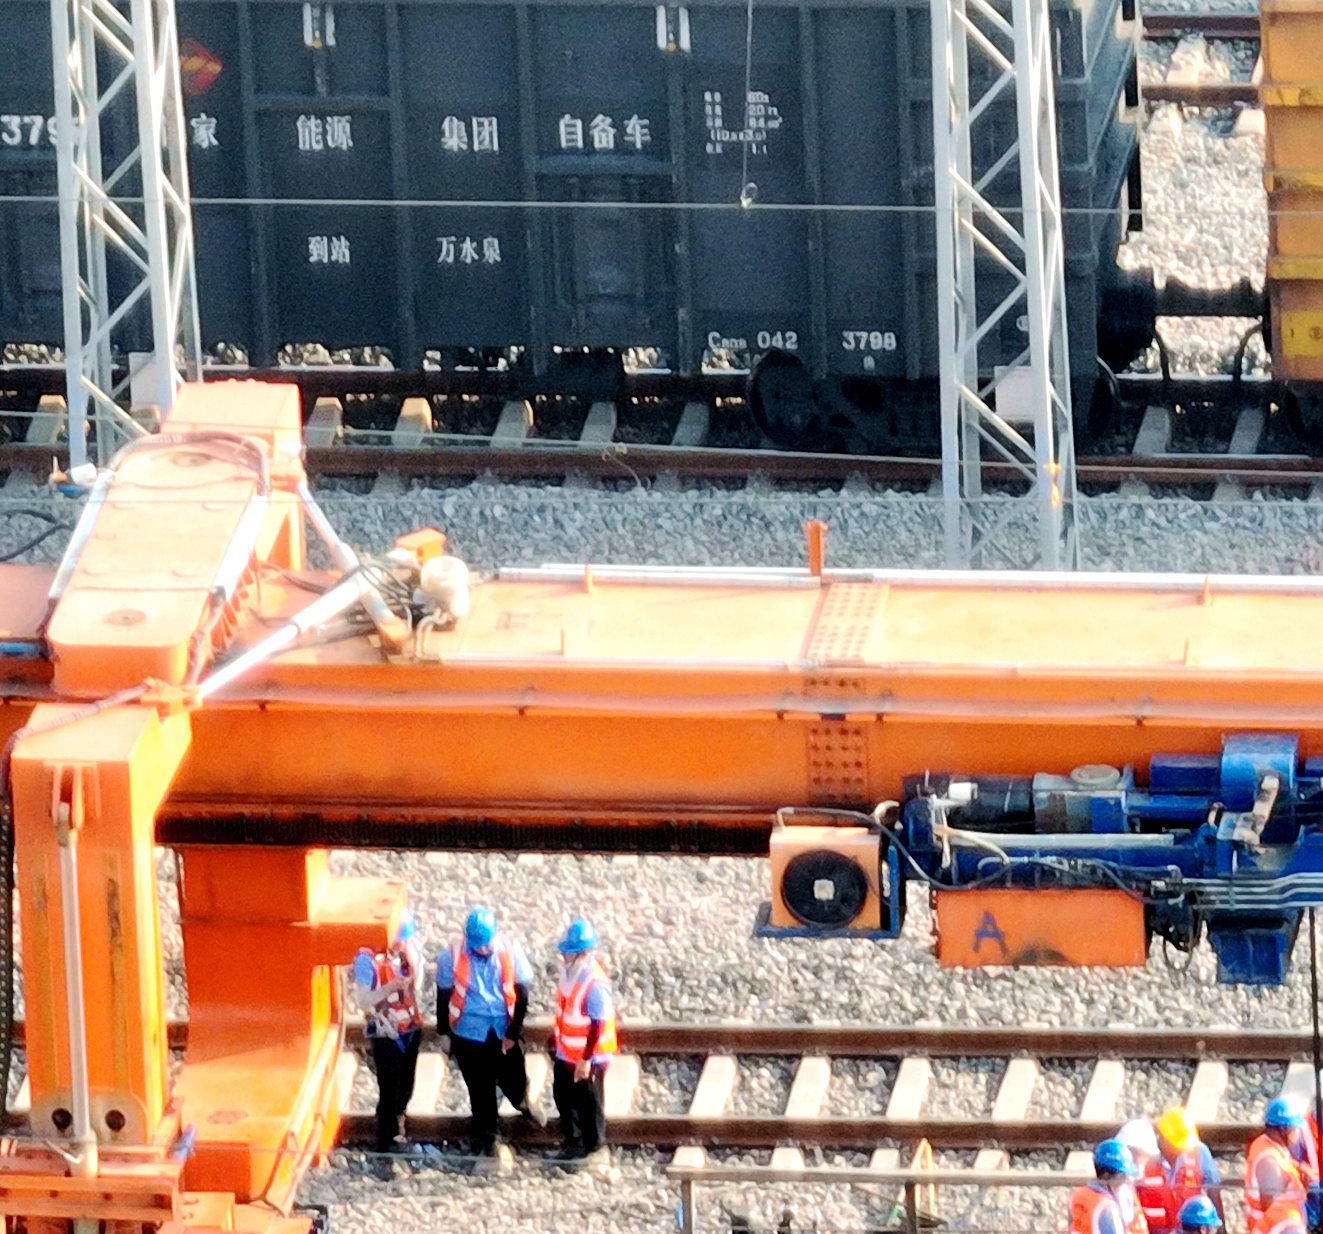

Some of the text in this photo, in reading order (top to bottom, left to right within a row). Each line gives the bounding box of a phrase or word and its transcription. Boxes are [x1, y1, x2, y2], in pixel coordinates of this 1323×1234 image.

[296, 114, 353, 151] 能源
[441, 116, 499, 152] 集团
[558, 113, 651, 150] 自备车
[308, 235, 501, 264] 到站 万水泉
[757, 331, 798, 350] 042
[973, 910, 1008, 958] A
